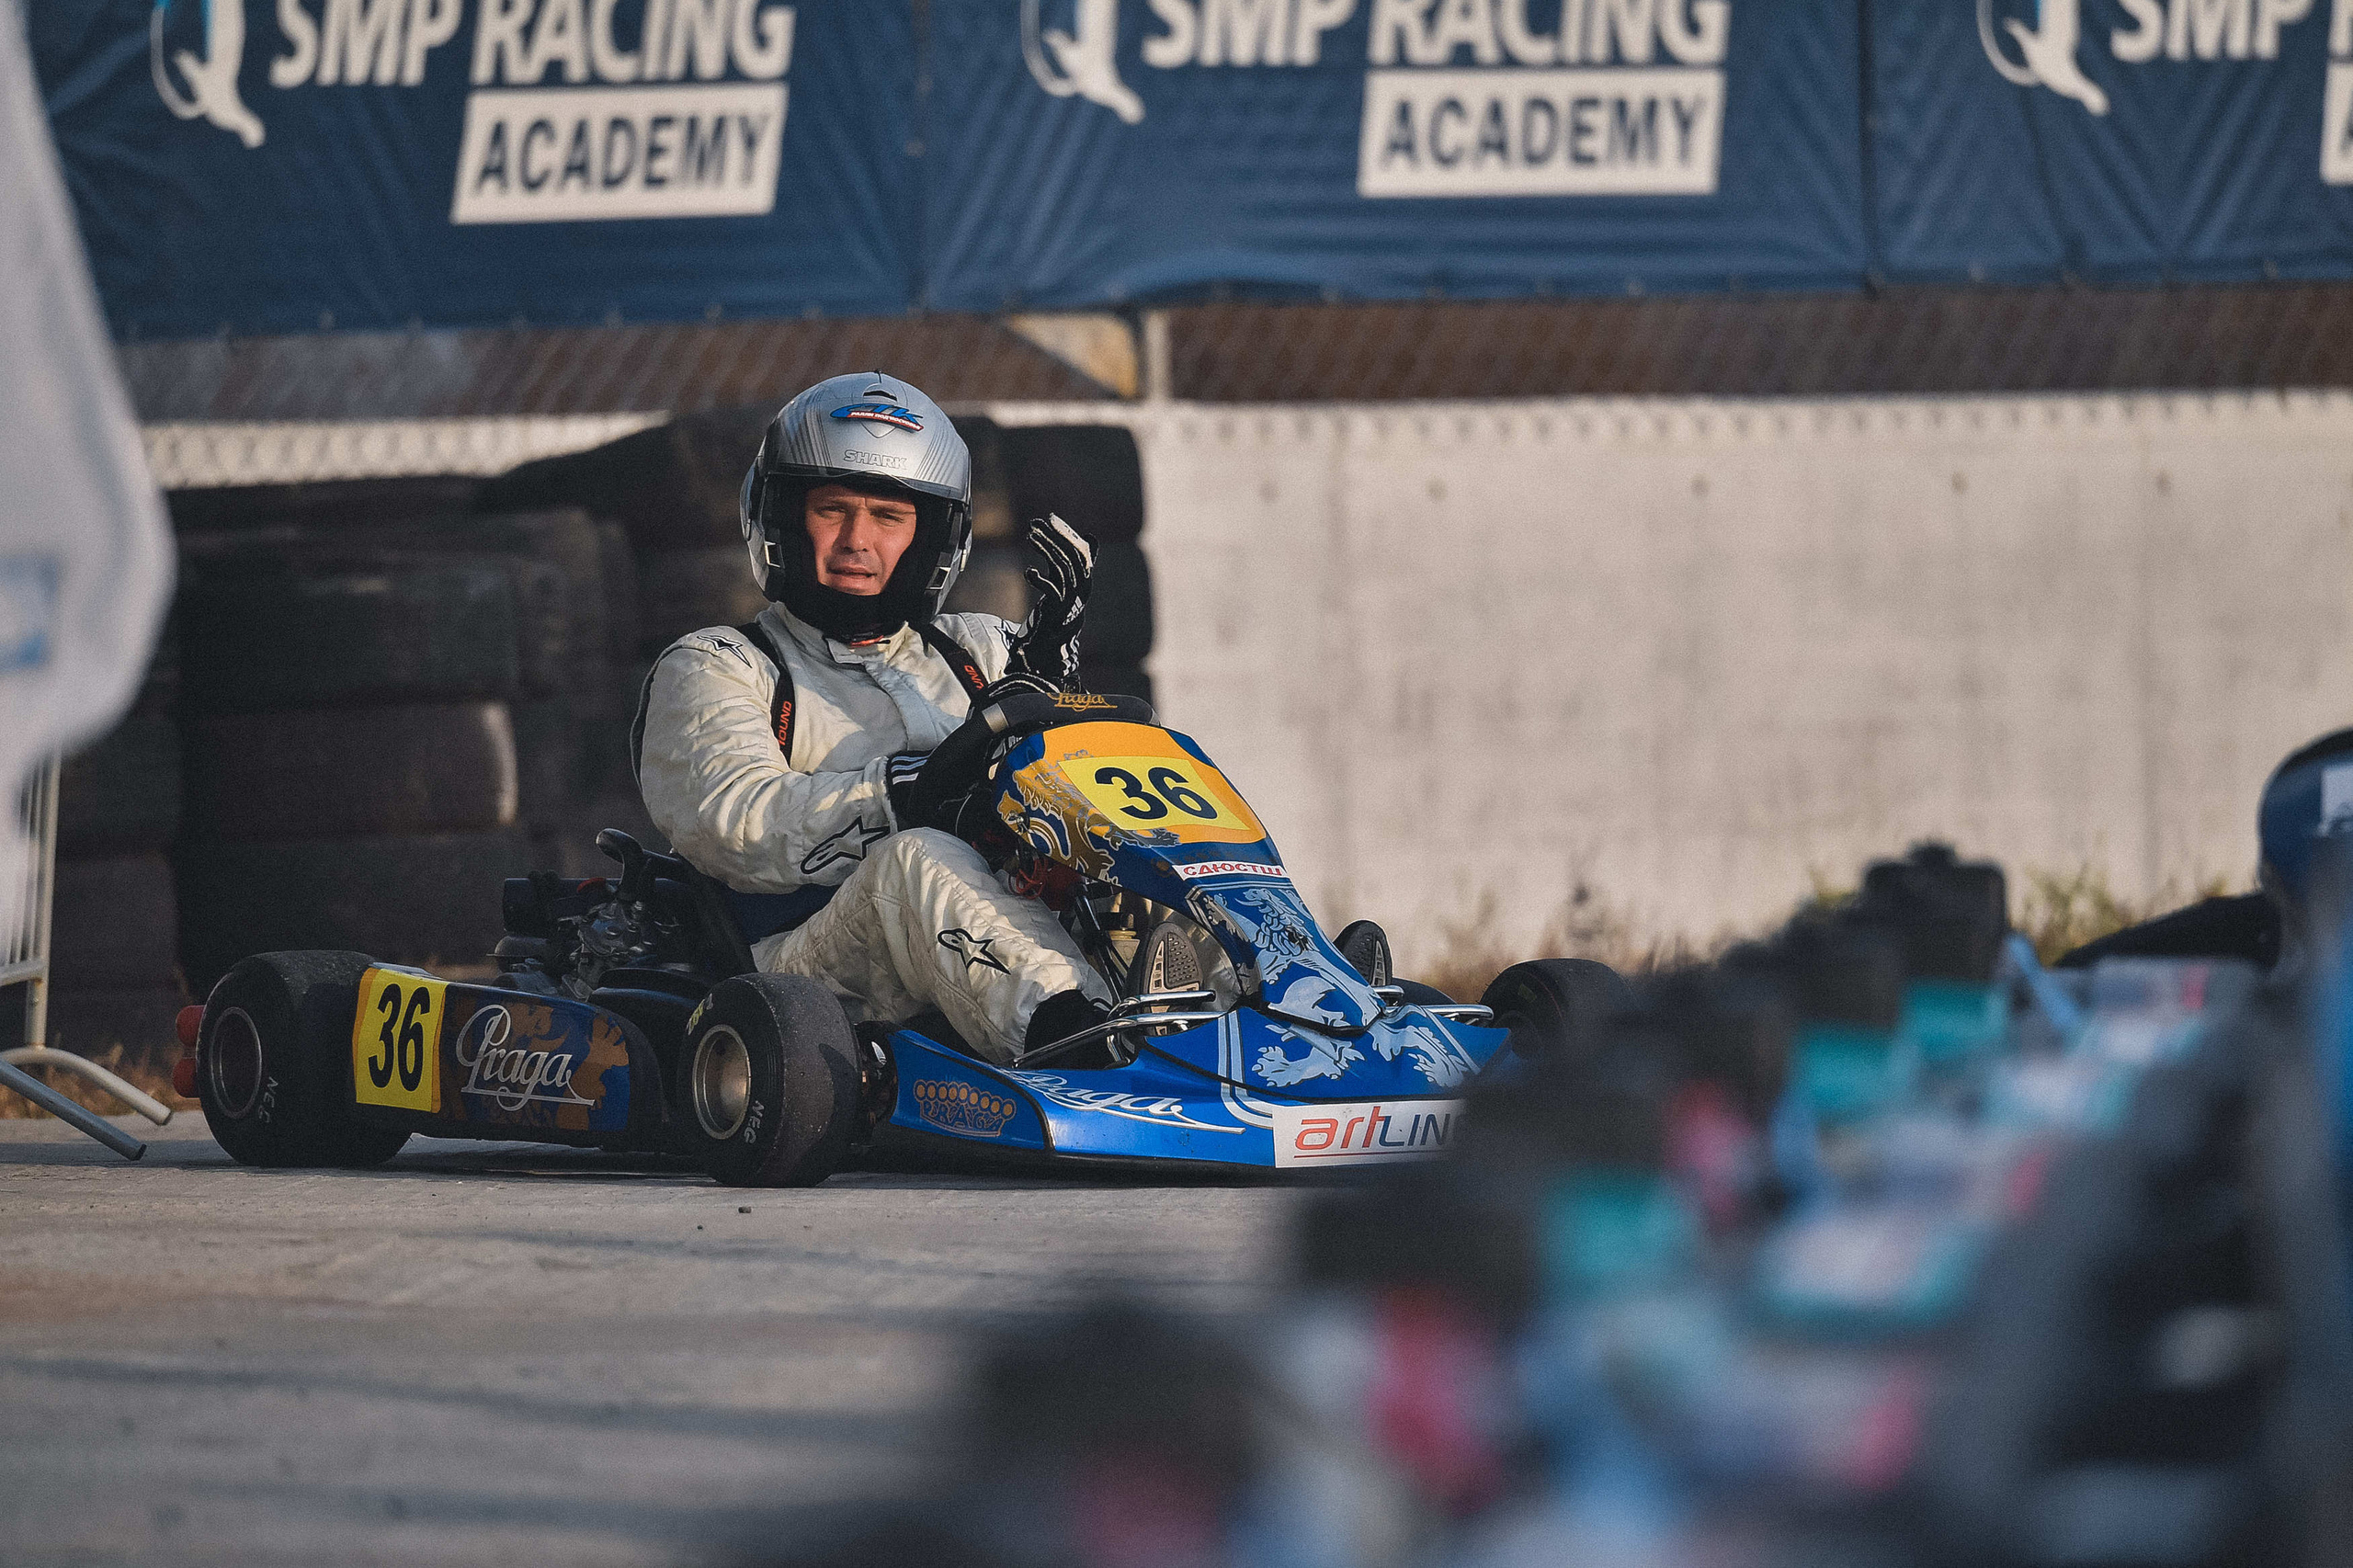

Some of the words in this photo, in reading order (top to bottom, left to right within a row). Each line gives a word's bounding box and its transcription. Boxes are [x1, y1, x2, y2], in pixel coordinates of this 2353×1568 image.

[269, 0, 460, 87] SMP
[470, 0, 796, 85] RACING
[1141, 0, 1356, 67] SMP
[1367, 0, 1731, 65] RACING
[473, 113, 775, 196] ACADEMY
[1381, 97, 1706, 169] ACADEMY
[843, 449, 907, 470] SHARK
[1094, 766, 1218, 820] 36
[368, 983, 430, 1093] 36
[456, 1004, 596, 1112] Praga
[1295, 1106, 1471, 1150] artLIN
